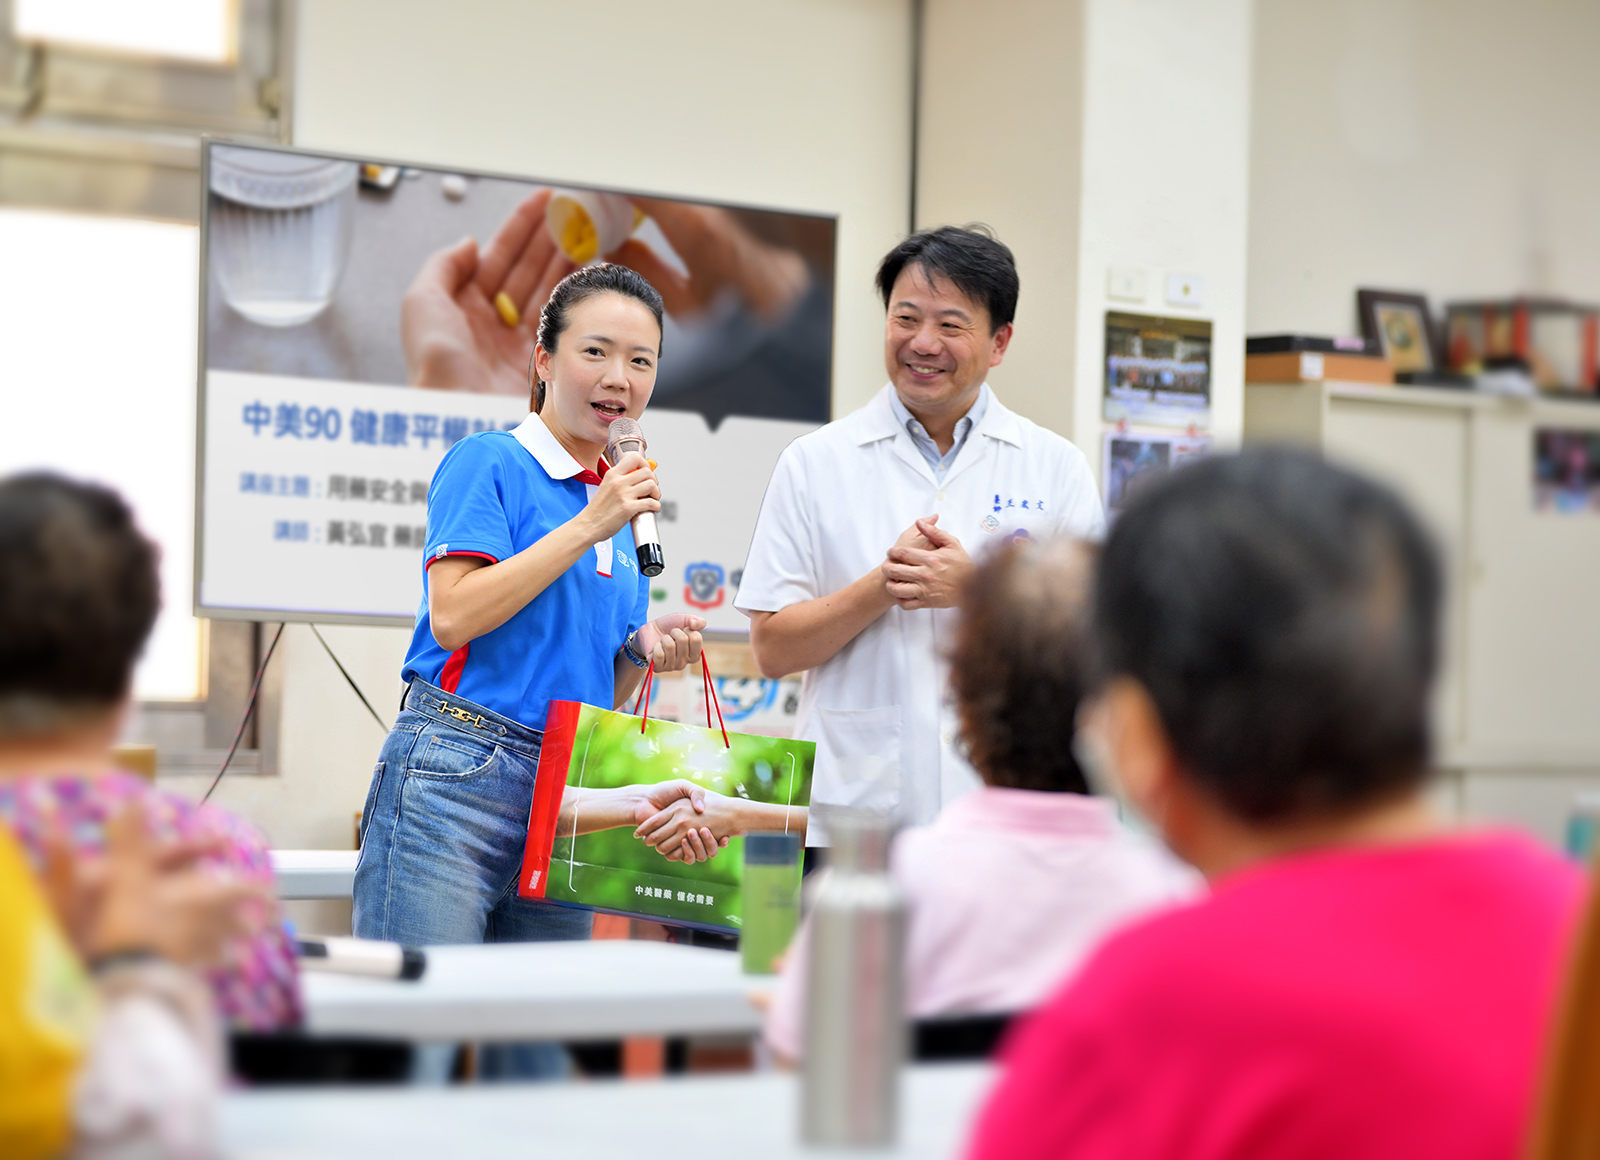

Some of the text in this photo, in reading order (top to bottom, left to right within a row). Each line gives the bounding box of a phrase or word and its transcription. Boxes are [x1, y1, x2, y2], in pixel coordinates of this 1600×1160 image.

[243, 401, 522, 449] 中美90 健康平權
[635, 885, 714, 906] 中美醫藥 懂你需要
